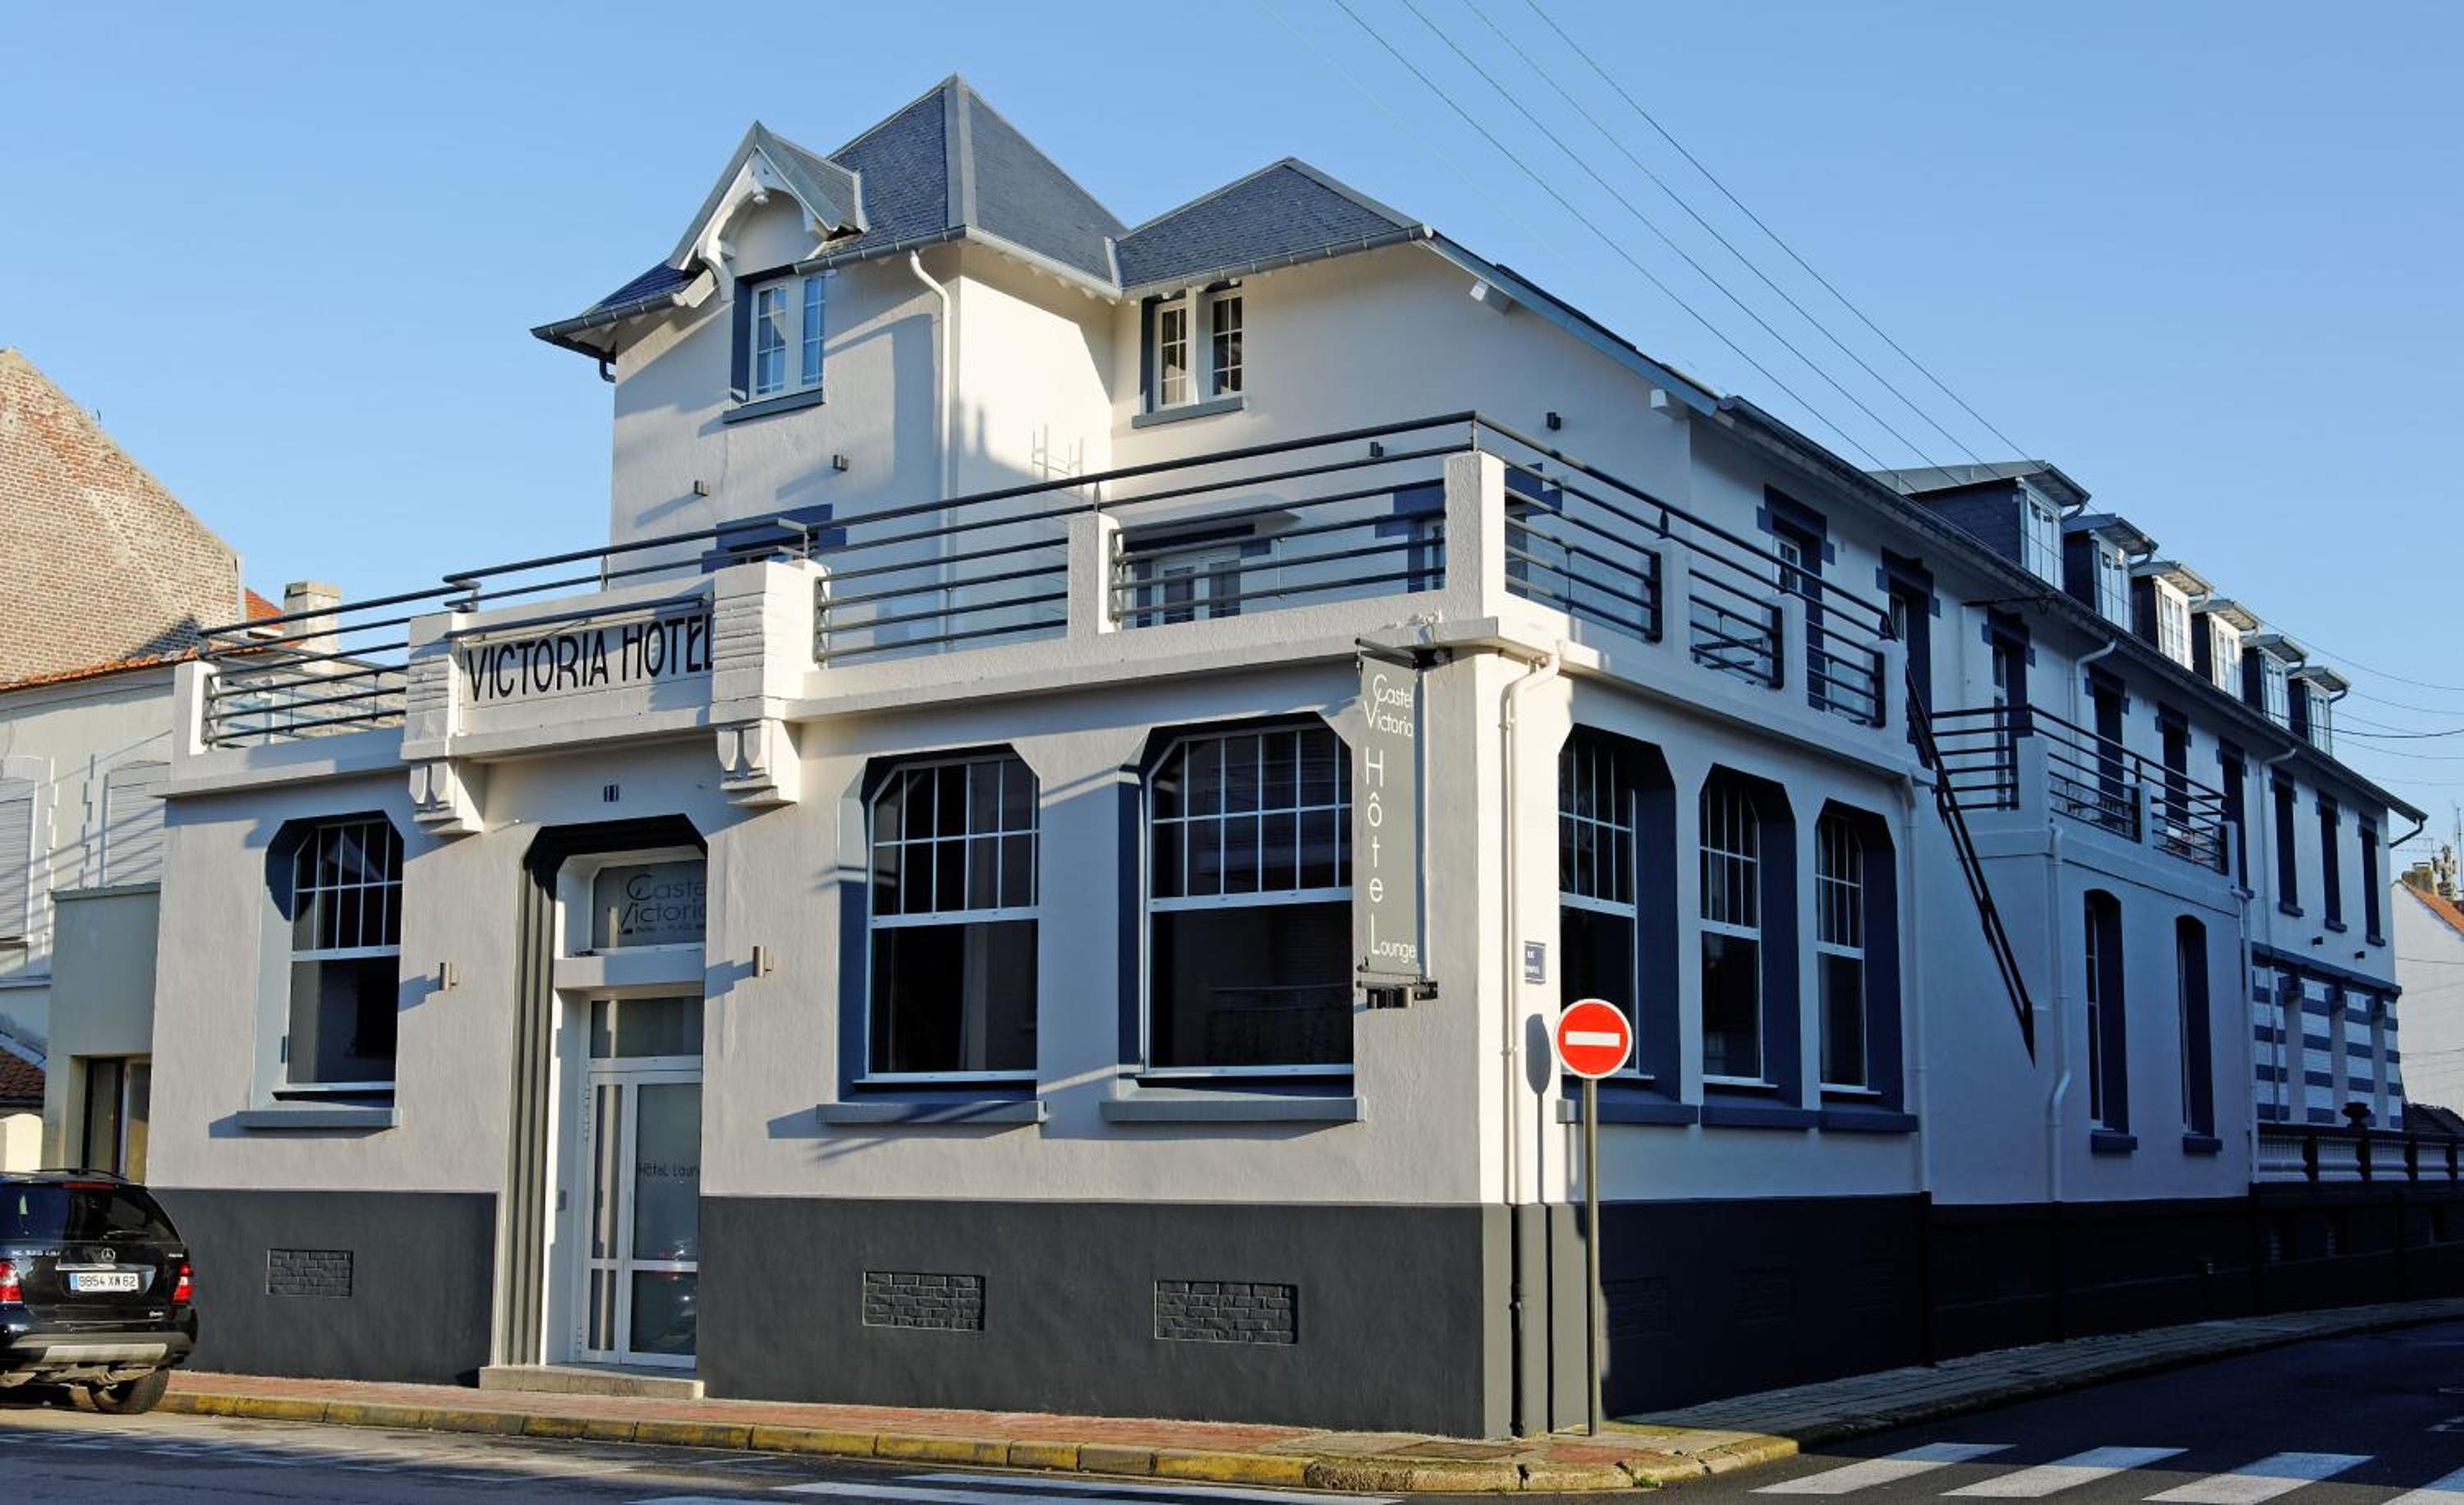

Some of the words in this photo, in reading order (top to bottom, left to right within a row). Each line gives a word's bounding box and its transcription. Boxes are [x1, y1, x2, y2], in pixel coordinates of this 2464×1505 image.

[467, 630, 609, 702] VICTORIA
[622, 613, 714, 682] HOTEL
[1364, 688, 1414, 737] Victoria
[1372, 674, 1414, 711] Castel
[627, 873, 706, 901] Caste
[1371, 911, 1416, 964] Lounge
